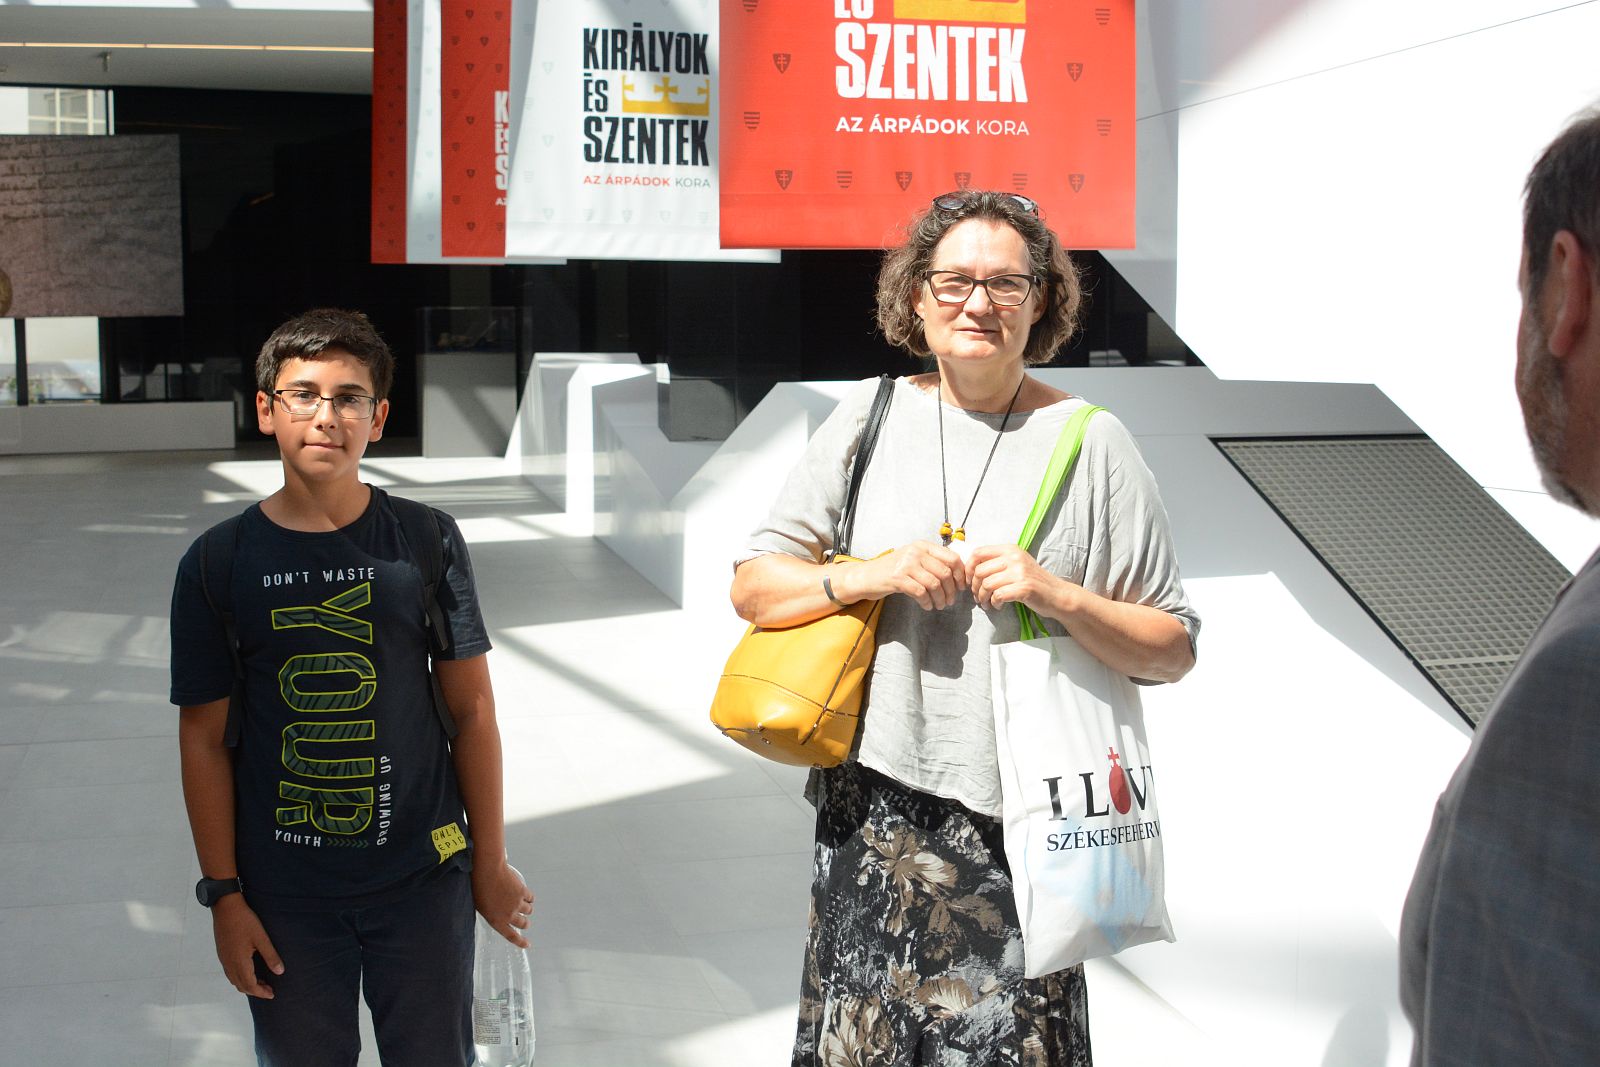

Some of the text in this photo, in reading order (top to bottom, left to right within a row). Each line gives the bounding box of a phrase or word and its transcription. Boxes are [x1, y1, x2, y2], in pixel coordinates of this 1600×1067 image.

[583, 22, 709, 75] KIRÁLYOK
[835, 22, 1028, 103] SZENTEK
[583, 73, 608, 112] ÉS
[583, 116, 709, 166] SZENTEK
[835, 114, 1029, 136] AZ ÁRPÁDOK KORA
[583, 173, 711, 188] AZ ÁRPÁDOK KORA
[263, 567, 375, 587] DON'T WASTE
[271, 582, 377, 834] YOUR
[377, 755, 391, 846] GROWING UP
[1043, 776, 1067, 821] I
[275, 829, 322, 847] YOUTH
[434, 825, 457, 841] ONLY
[438, 836, 464, 851] EPIC
